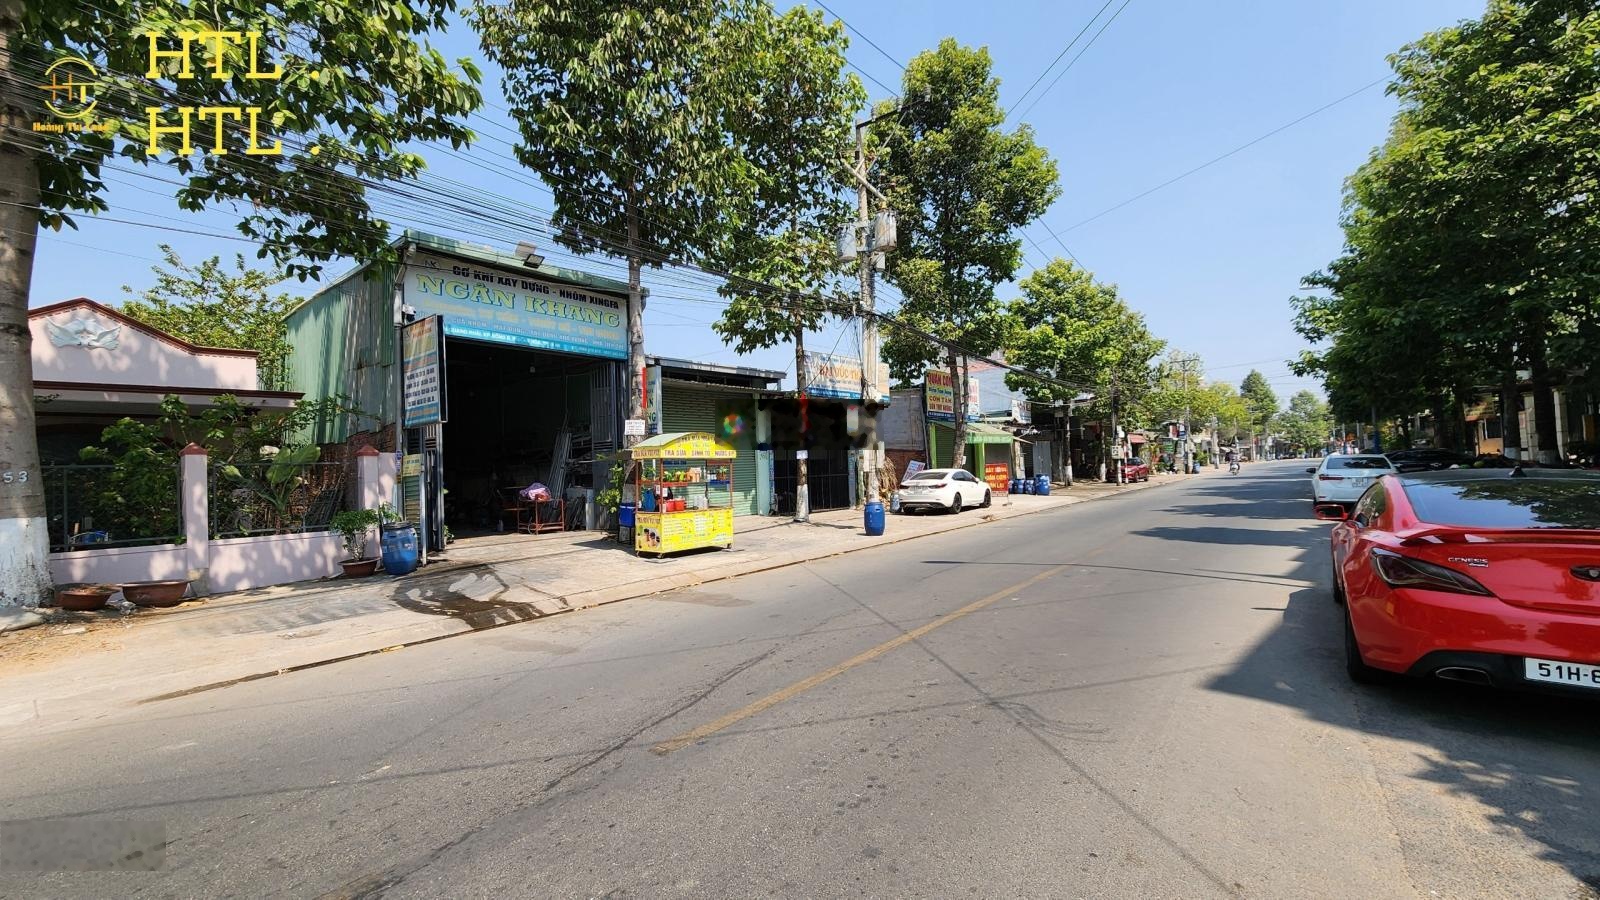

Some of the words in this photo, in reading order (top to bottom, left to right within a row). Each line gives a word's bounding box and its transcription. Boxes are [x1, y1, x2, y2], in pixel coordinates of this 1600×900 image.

[521, 279, 550, 295] DỰNG
[559, 288, 587, 303] NHÔM
[525, 295, 620, 328] KHANG
